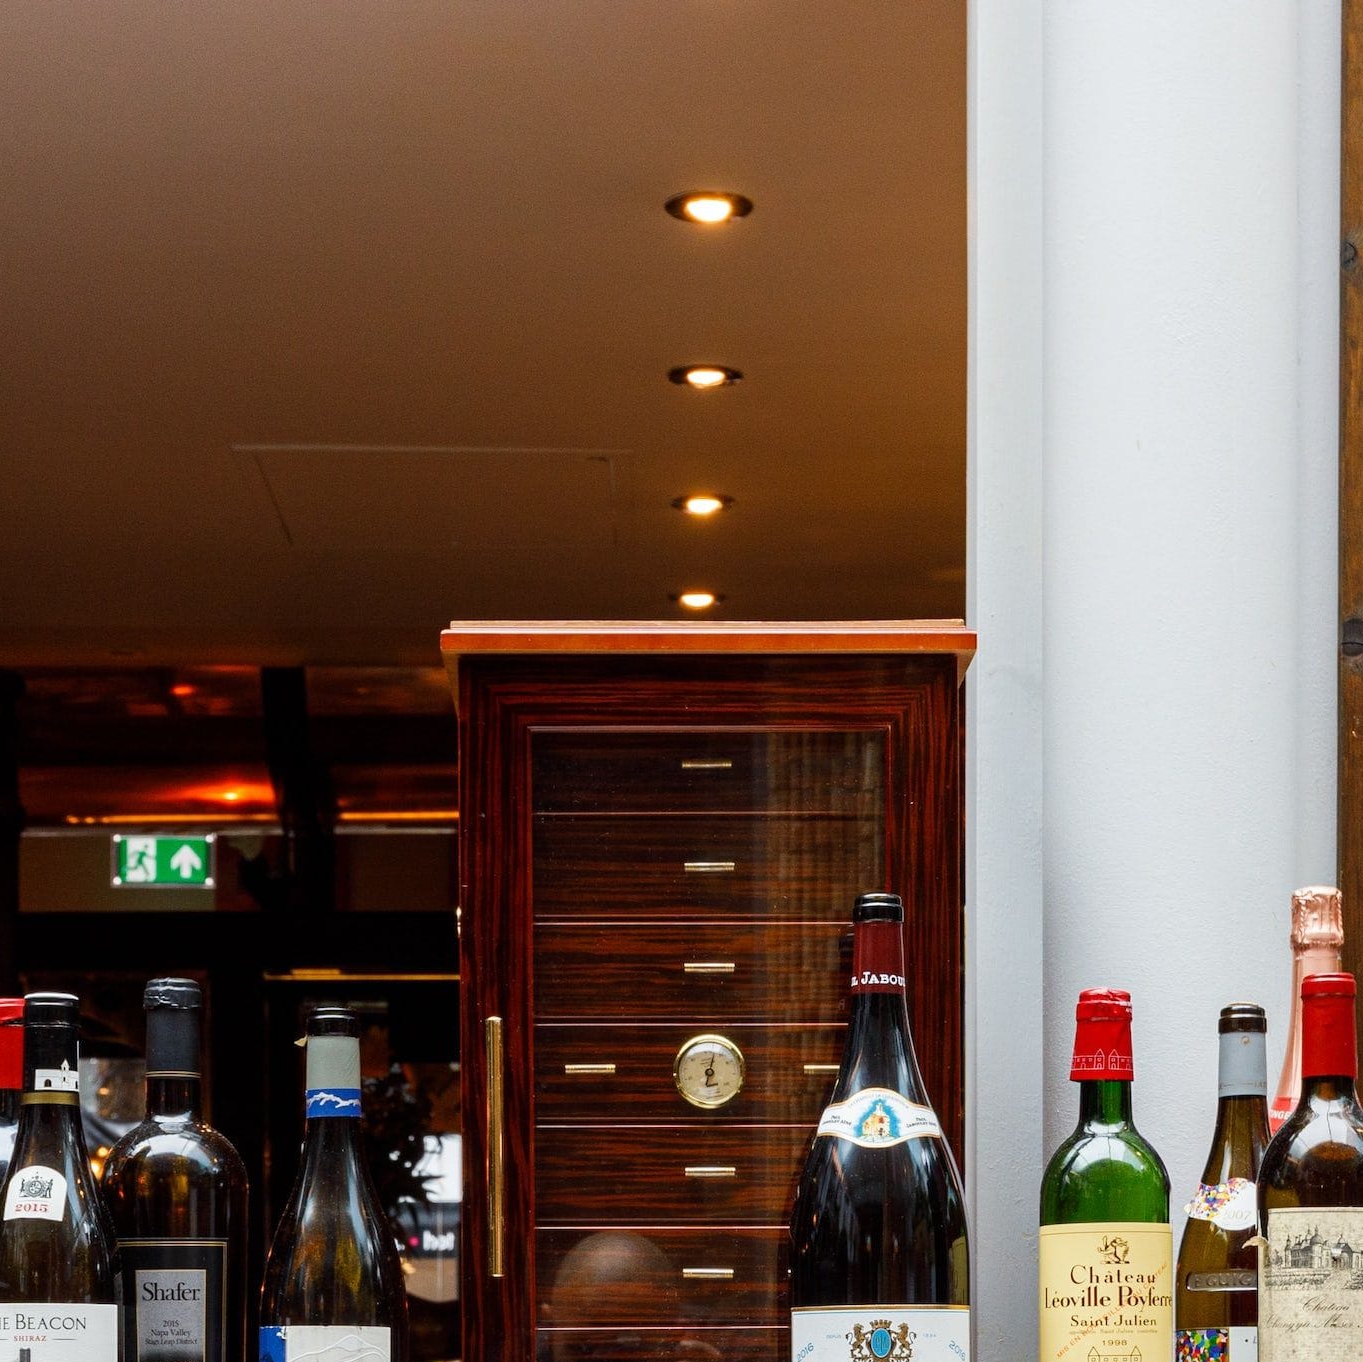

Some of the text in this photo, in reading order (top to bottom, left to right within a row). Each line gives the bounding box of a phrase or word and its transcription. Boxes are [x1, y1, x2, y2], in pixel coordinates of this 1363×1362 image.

[14, 1203, 49, 1213] 2015
[1069, 1263, 1157, 1285] Château
[141, 1281, 201, 1301] Shafer
[1045, 1285, 1112, 1309] Léoville
[15, 1313, 87, 1331] BEACON
[162, 1319, 180, 1328] 2015
[1069, 1314, 1158, 1328] Saint Julien
[150, 1328, 192, 1338] Napa Valley
[1101, 1339, 1128, 1347] 1998
